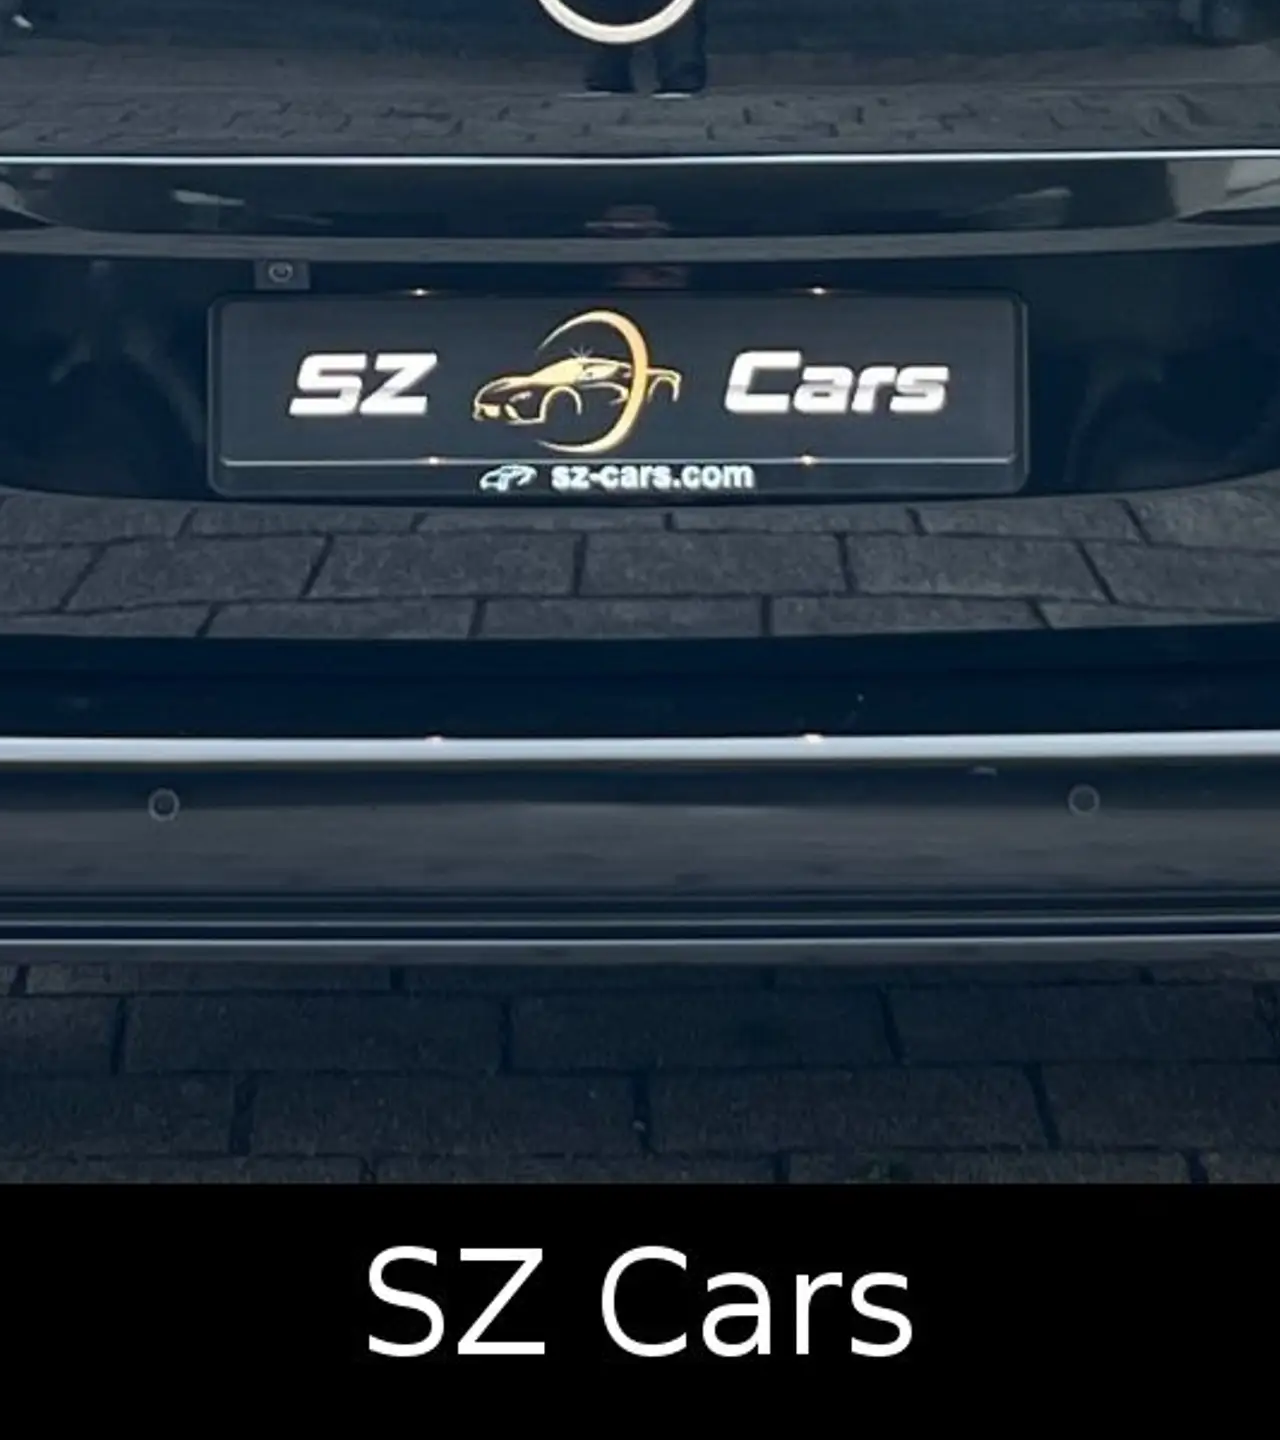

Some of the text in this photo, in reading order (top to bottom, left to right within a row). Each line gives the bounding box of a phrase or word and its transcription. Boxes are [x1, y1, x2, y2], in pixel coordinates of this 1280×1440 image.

[288, 350, 951, 417] SZ Cars
[551, 464, 755, 491] sz-cars.com
